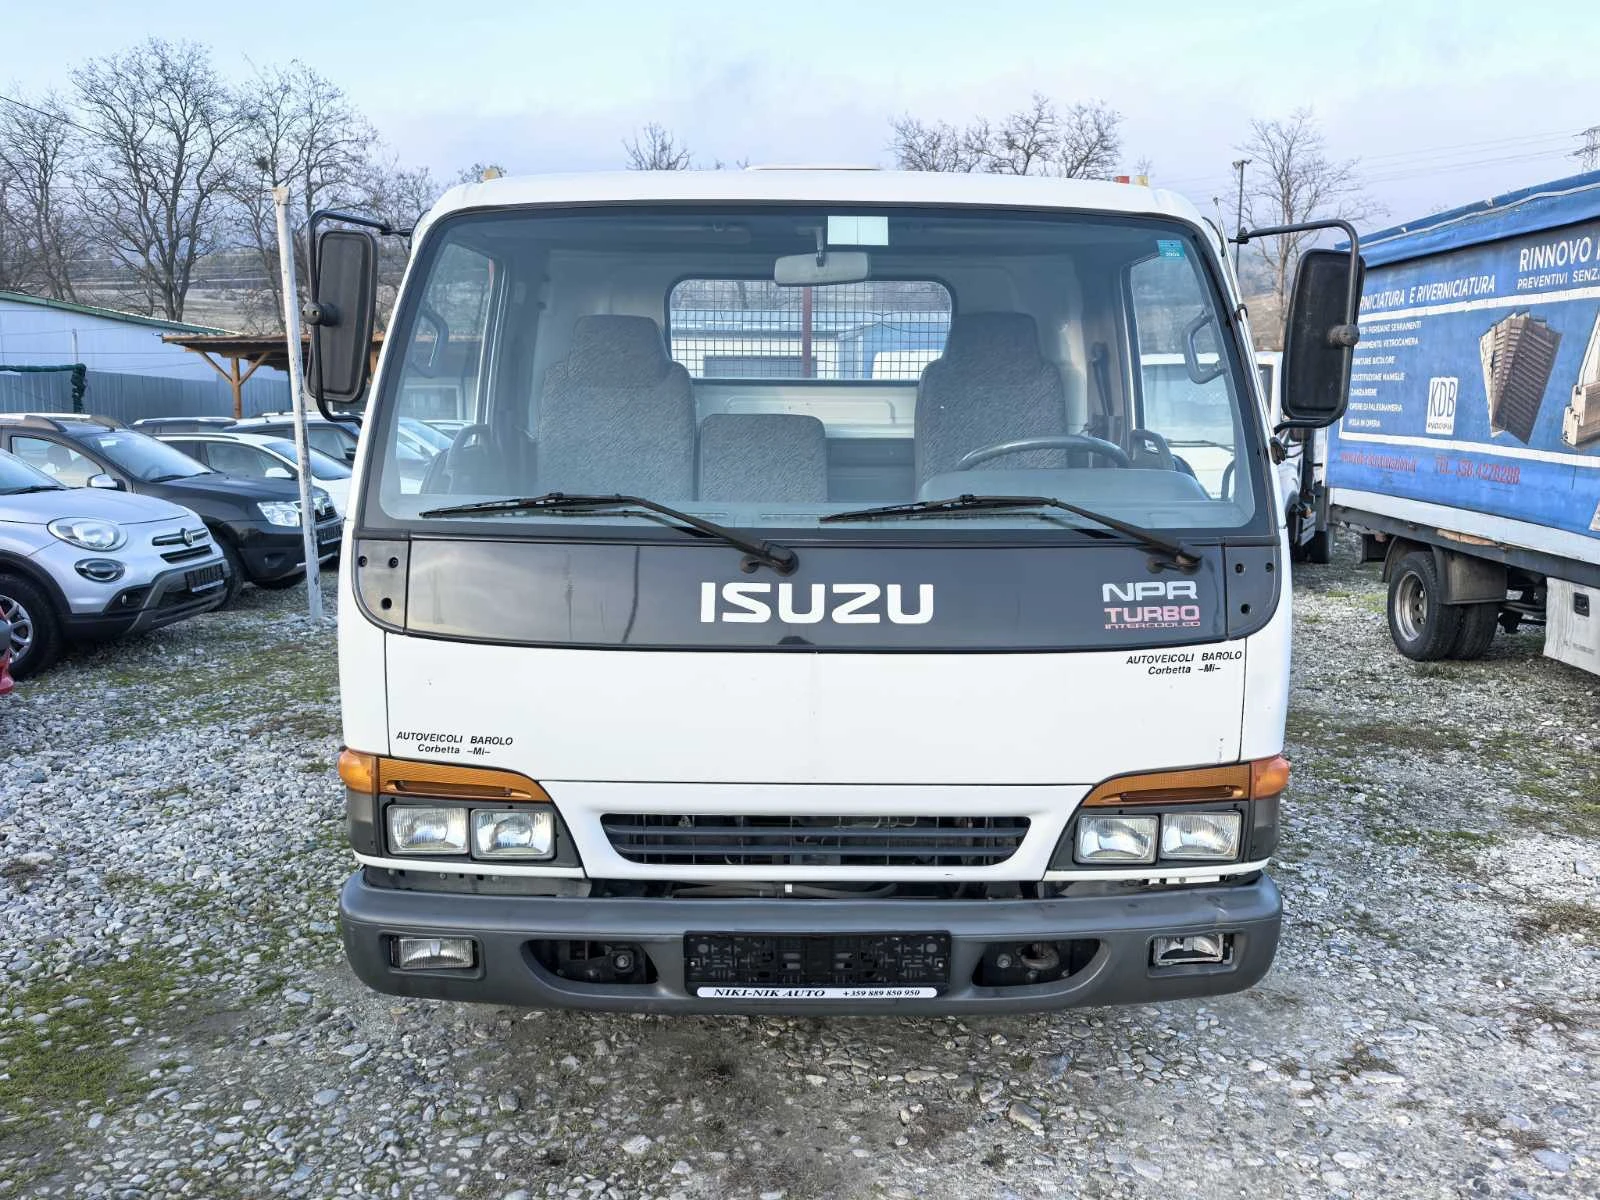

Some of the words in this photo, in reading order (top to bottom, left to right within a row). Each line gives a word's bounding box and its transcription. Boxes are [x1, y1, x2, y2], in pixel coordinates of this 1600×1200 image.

[1519, 237, 1592, 273] RINNOVO
[1517, 271, 1568, 290] PREVENTIVI
[1572, 267, 1600, 283] SENZ
[1359, 289, 1405, 312] RNICIATURA
[1409, 286, 1417, 304] E
[1416, 275, 1496, 303] RIVERNICIATURA
[1430, 381, 1456, 417] KDB
[1102, 580, 1199, 602] NPR
[700, 581, 934, 625] ISUZU
[1104, 604, 1201, 623] TURBO
[1126, 653, 1195, 665] AUTOVEICOLI
[1201, 650, 1243, 662] BAROLO
[1148, 665, 1192, 675] Corbetta
[396, 731, 464, 743] AUTOVEICOLI
[470, 735, 514, 746] BAROLO
[417, 743, 461, 754] Corbetta
[713, 988, 779, 998] NIKI-NIK
[783, 988, 826, 998] AUTO
